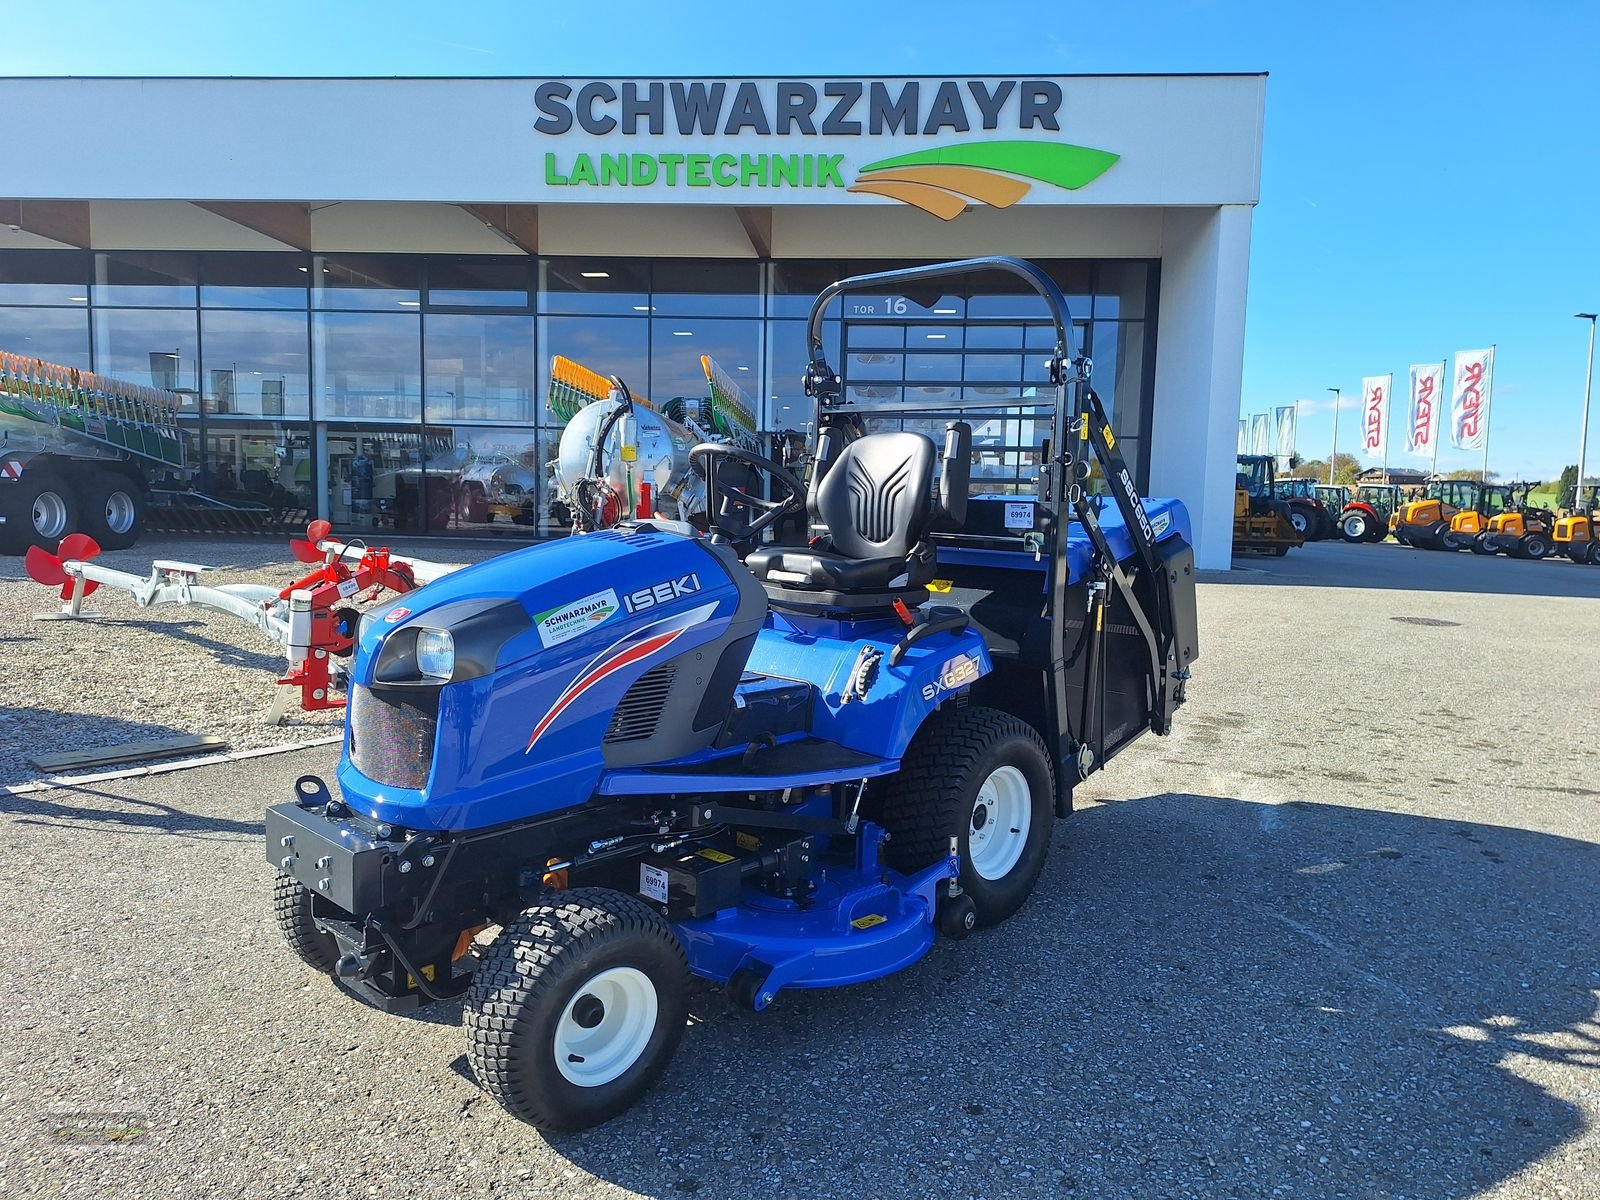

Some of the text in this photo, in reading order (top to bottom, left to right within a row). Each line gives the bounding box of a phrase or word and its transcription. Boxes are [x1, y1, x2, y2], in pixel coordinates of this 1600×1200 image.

[533, 81, 1063, 136] SCHWARZMAYR
[544, 152, 845, 188] LANDTECHNIK
[853, 297, 907, 314] TOR 16
[1010, 511, 1031, 519] 69974
[1120, 468, 1152, 541] SBC650
[623, 573, 702, 614] ISEKI
[544, 600, 607, 628] SCHWARZMAYR
[548, 617, 588, 634] LANDTECHNIK
[922, 655, 981, 701] SXG327
[645, 875, 666, 889] 69974
